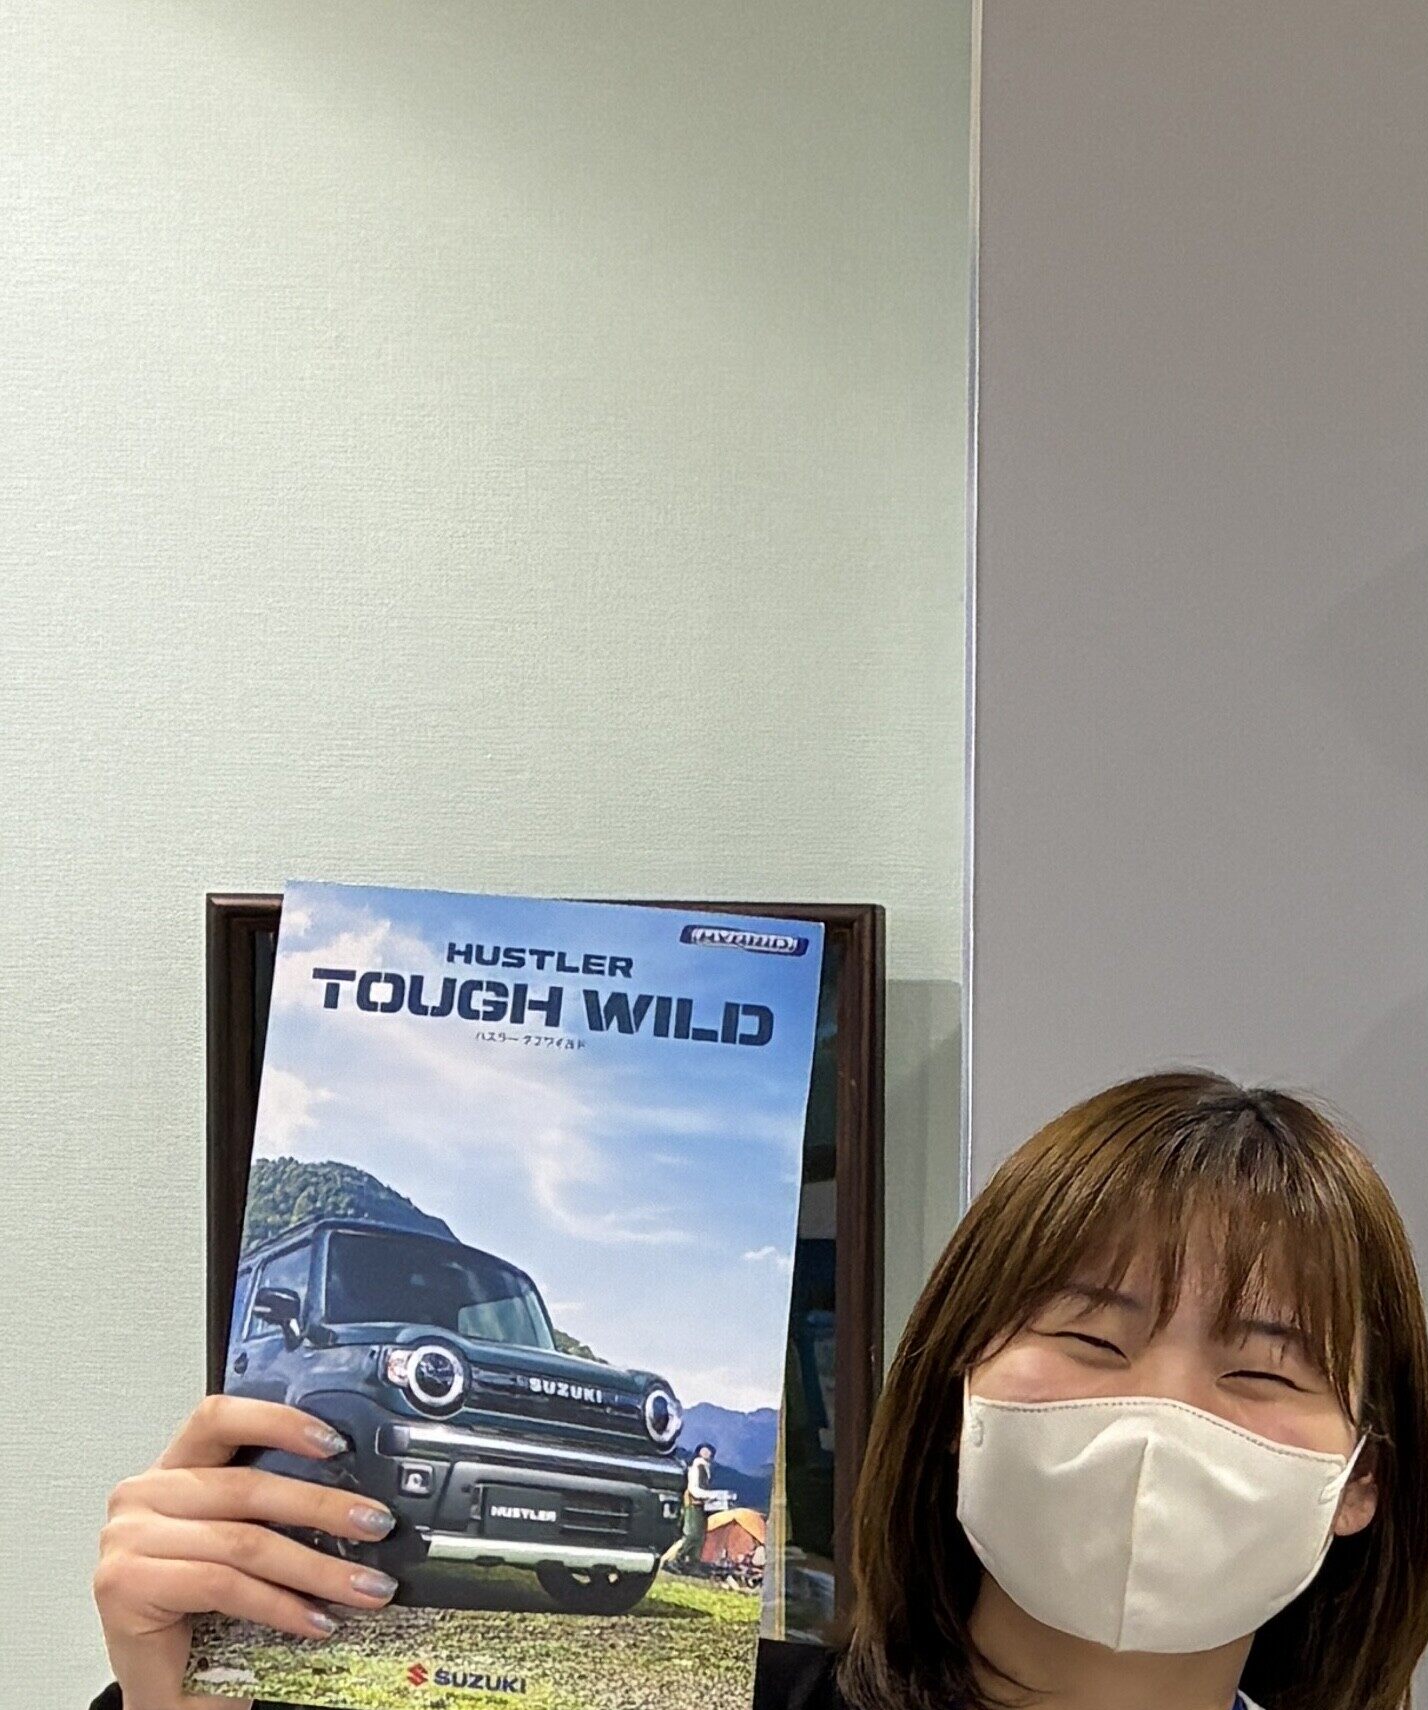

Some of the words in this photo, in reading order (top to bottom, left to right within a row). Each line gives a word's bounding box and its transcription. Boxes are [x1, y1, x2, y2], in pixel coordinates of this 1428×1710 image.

[446, 941, 634, 979] HUSTLER
[312, 968, 563, 1028] TOUGH
[582, 988, 774, 1047] WILD
[529, 1377, 603, 1403] SUZUKI
[491, 1505, 557, 1523] HUSTLER
[433, 1667, 527, 1694] SUZUKI
